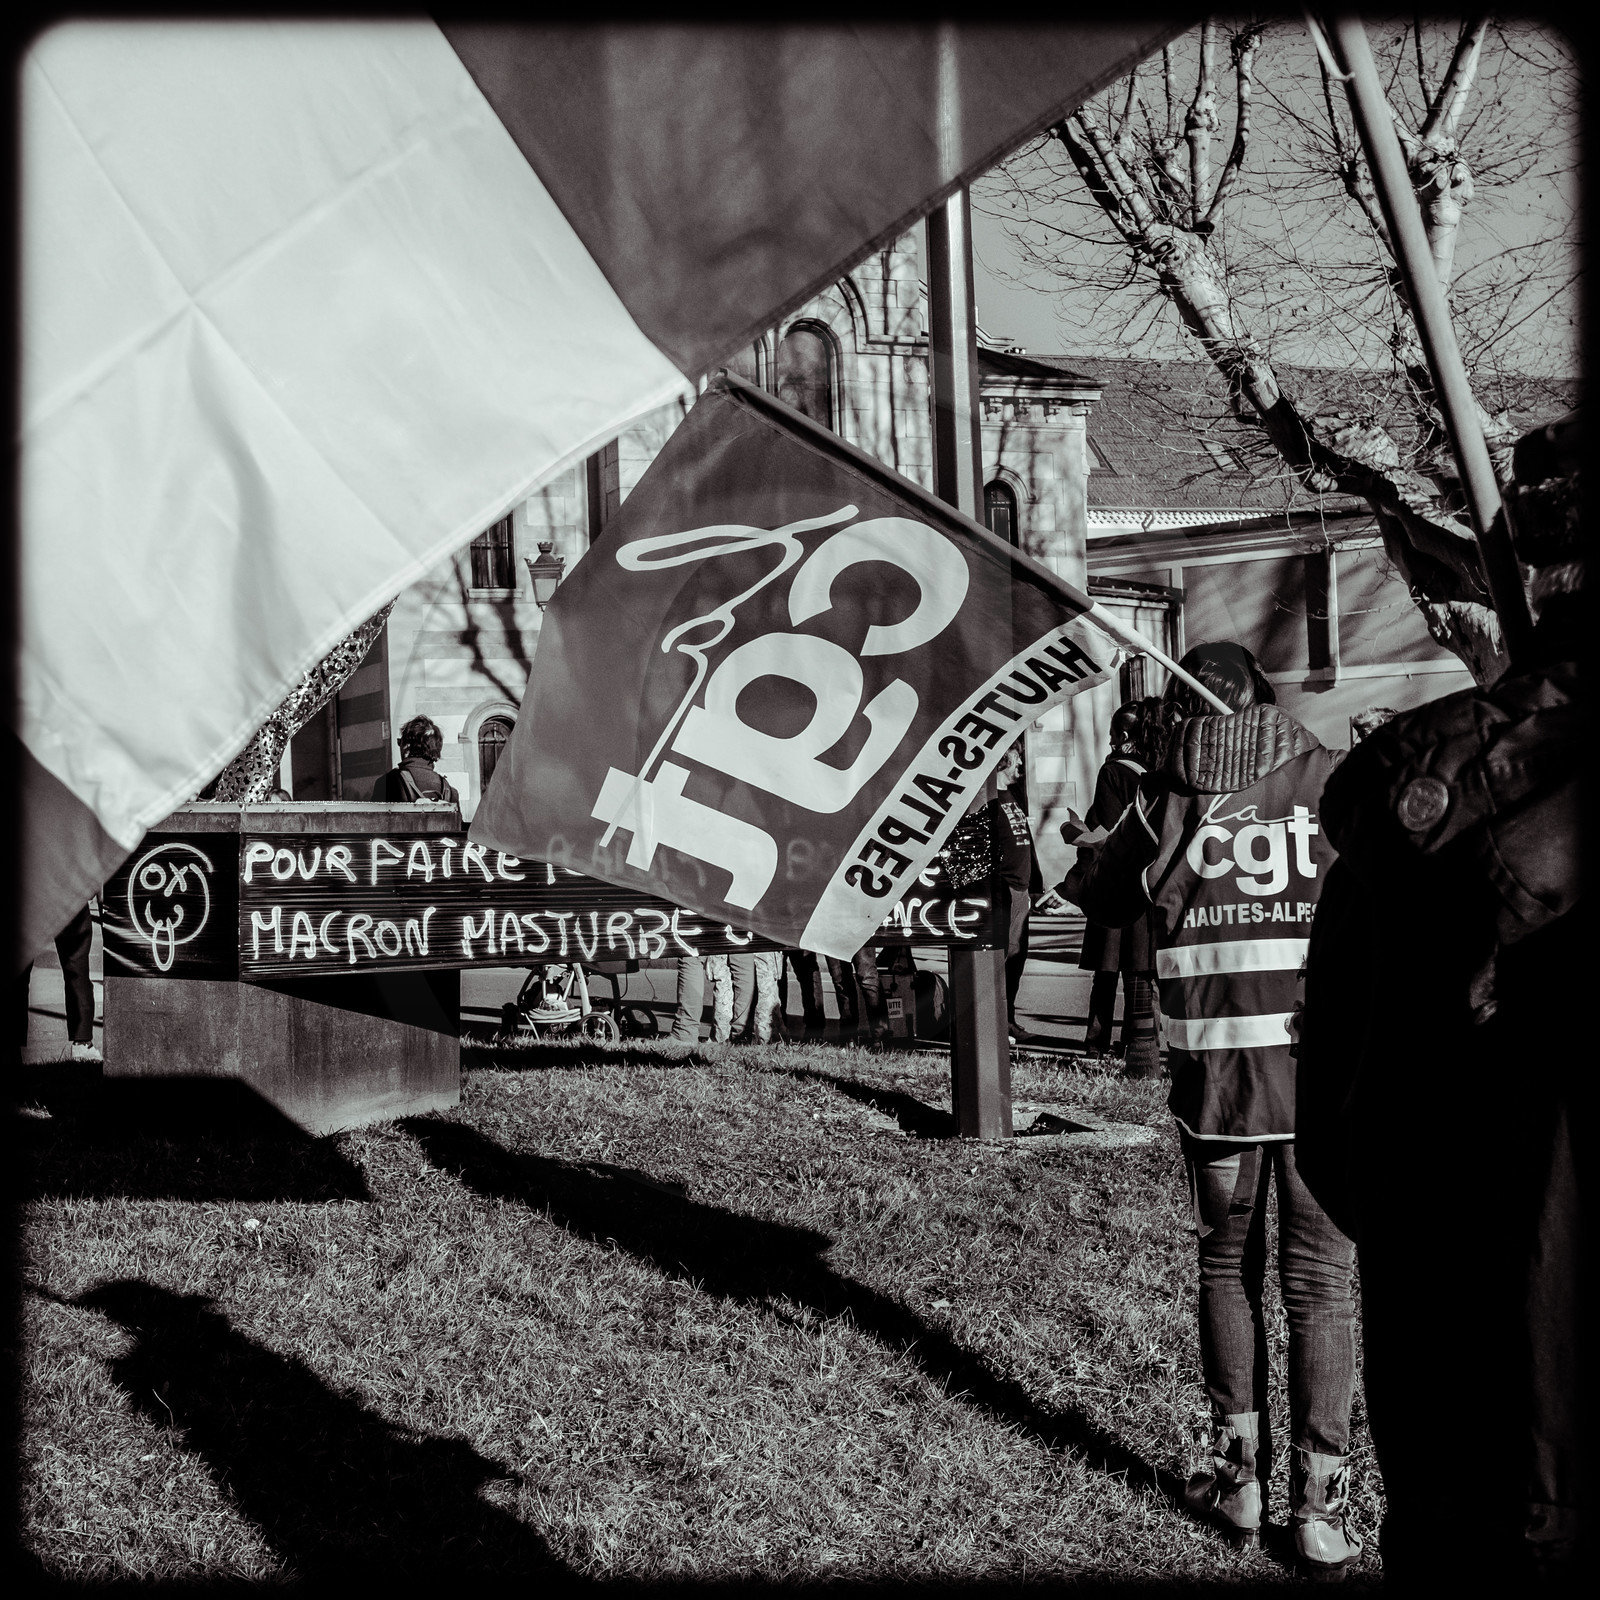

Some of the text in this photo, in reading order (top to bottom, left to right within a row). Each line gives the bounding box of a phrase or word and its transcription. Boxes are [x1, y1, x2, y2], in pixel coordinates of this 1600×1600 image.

[242, 841, 357, 883] POUR
[1186, 804, 1319, 897] cgt
[250, 905, 436, 964] MACRON
[461, 905, 703, 960] MASTURBE
